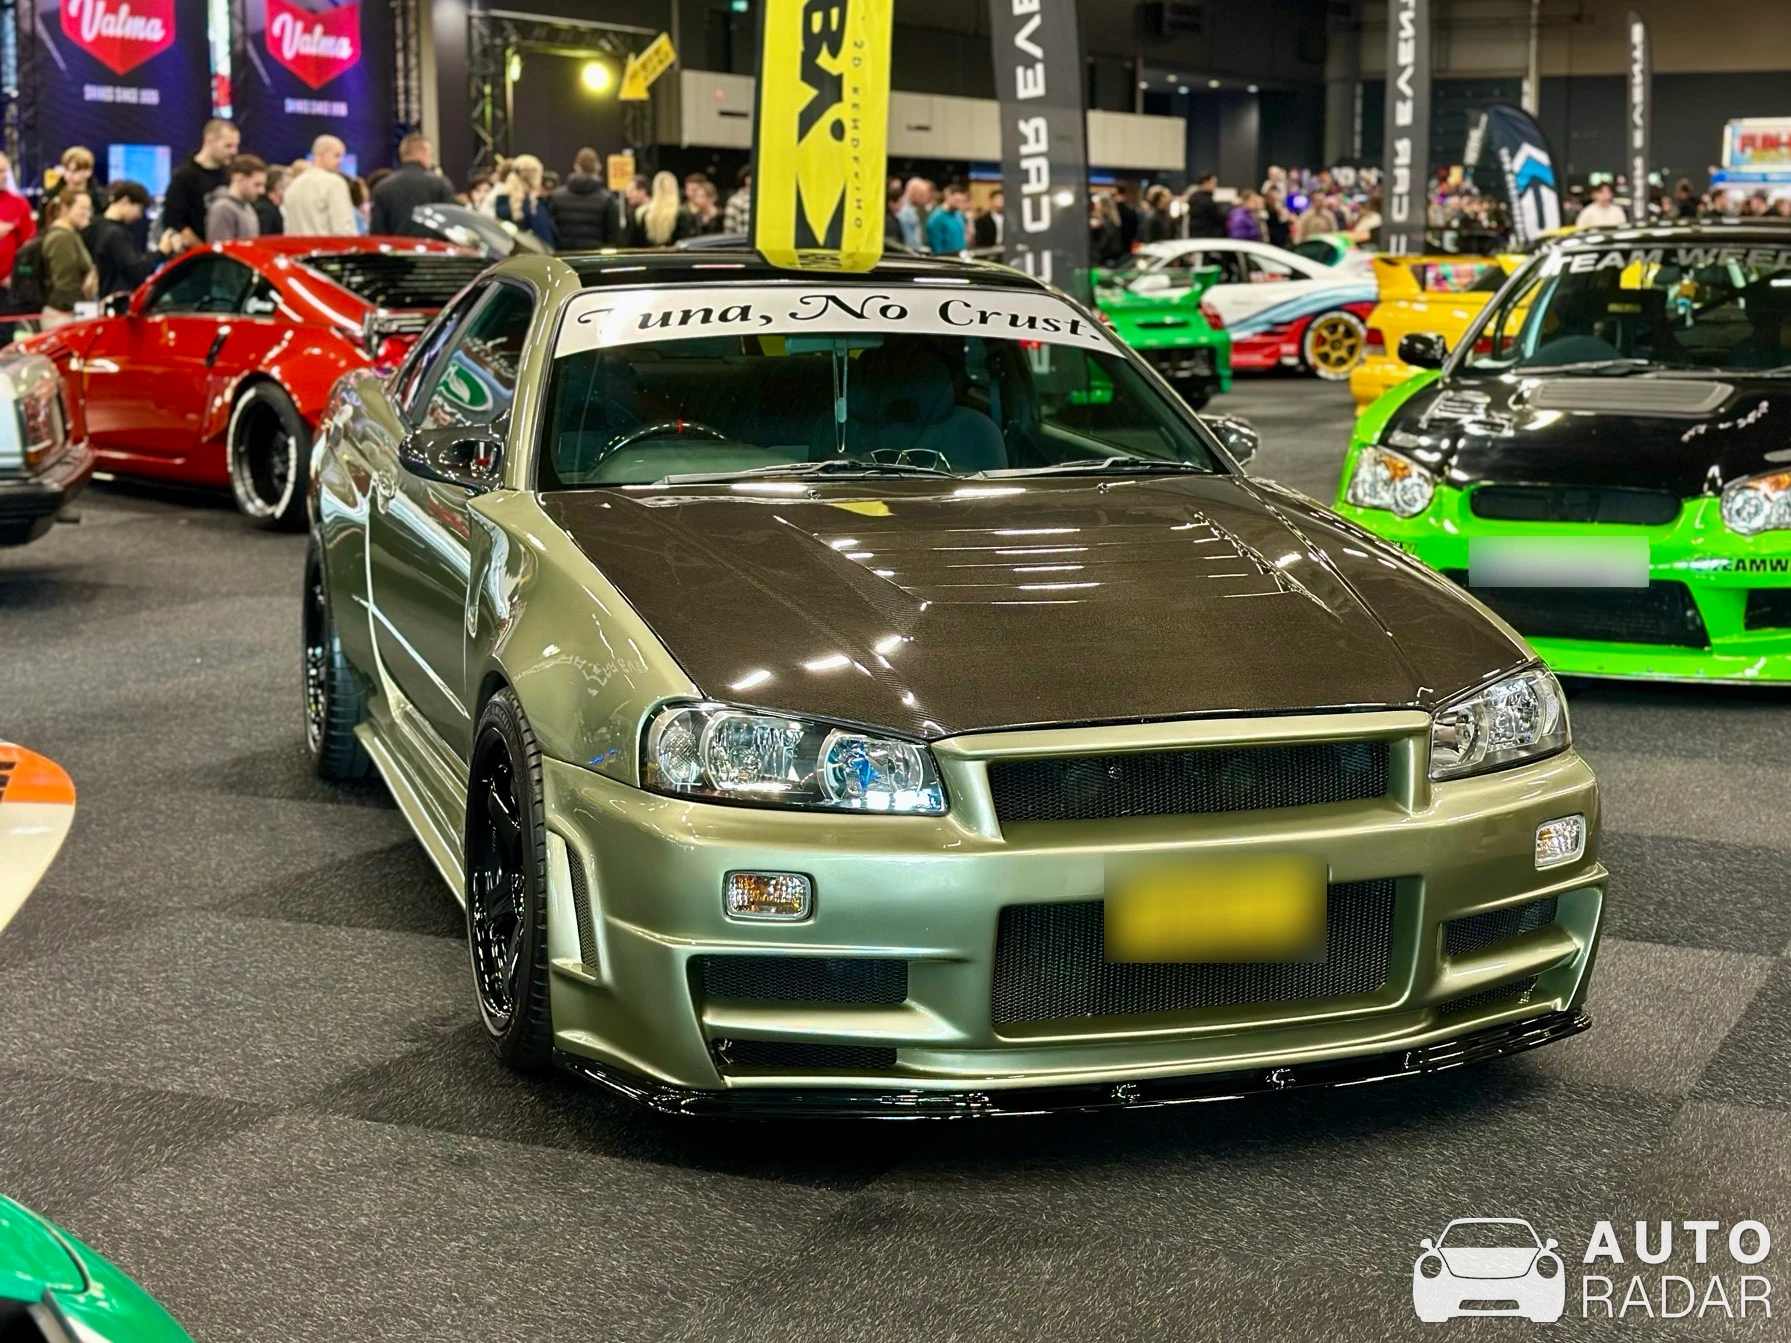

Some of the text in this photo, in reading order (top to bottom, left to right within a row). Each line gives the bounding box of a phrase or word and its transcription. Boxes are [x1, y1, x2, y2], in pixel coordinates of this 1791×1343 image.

[68, 0, 164, 42] Valma
[272, 12, 352, 60] Valma
[1546, 250, 1665, 275] TEAM
[788, 295, 908, 320] No
[938, 299, 1100, 341] Crust.
